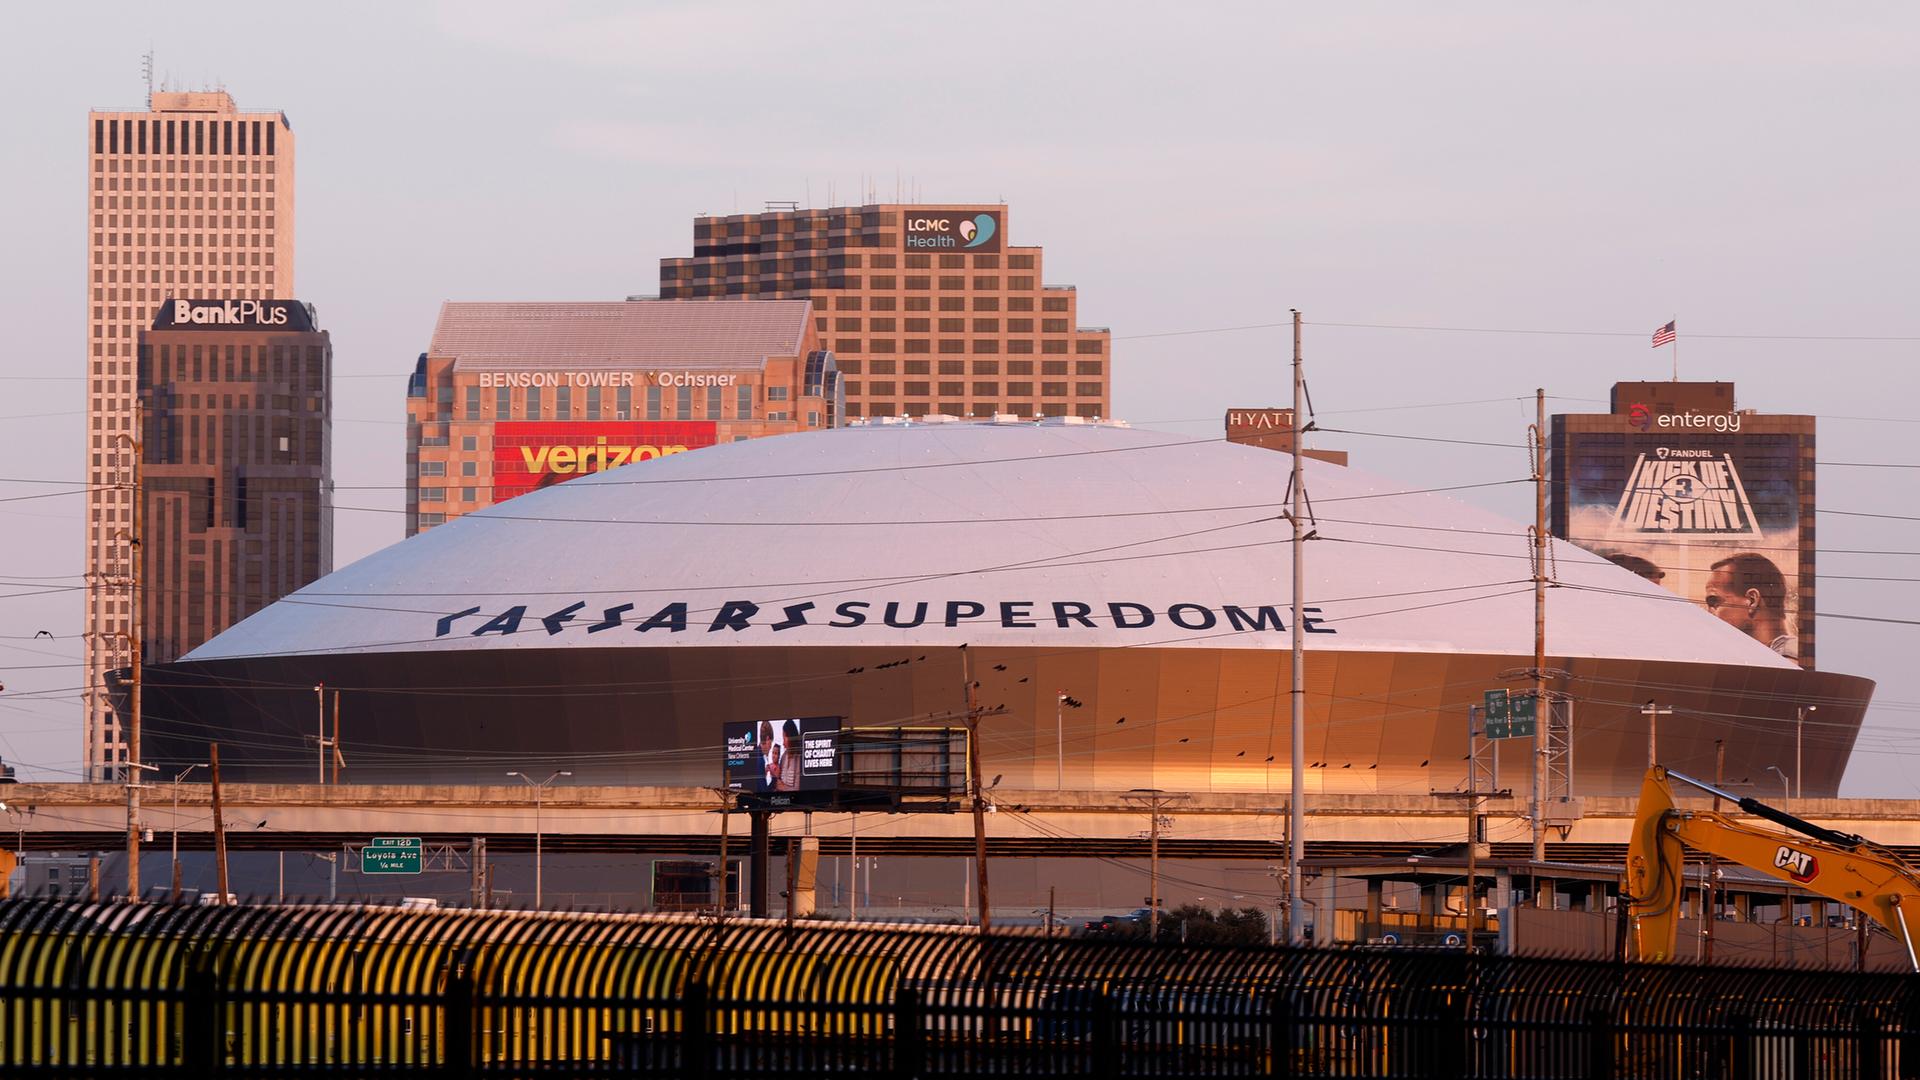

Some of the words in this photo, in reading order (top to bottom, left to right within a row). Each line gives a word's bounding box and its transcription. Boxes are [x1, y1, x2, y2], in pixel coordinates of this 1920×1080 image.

[908, 219, 950, 231] LCMC
[907, 235, 955, 247] Health
[174, 300, 288, 325] BankPlus
[479, 372, 559, 388] BENSON
[565, 372, 634, 387] TOWER
[658, 371, 737, 387] Ochsner
[1230, 413, 1294, 429] HYATT
[1657, 411, 1741, 432] entergy
[520, 436, 690, 474] verizo
[1671, 450, 1713, 458] FANDUEL
[1636, 460, 1699, 488] KICK
[1700, 460, 1729, 488] OF
[1676, 478, 1692, 497] 3
[1625, 489, 1743, 531] DESTINY
[829, 600, 1338, 634] SUPERDOME
[805, 740, 815, 749] THE
[815, 739, 832, 748] SPIRIT
[805, 749, 813, 759] OF
[813, 748, 836, 758] CHARITY
[805, 759, 819, 768] LIVES
[819, 758, 833, 767] HERE
[771, 796, 791, 805] Pelican
[366, 851, 397, 861] Loyola
[400, 851, 417, 859] Ave
[1774, 846, 1812, 876] CAT
